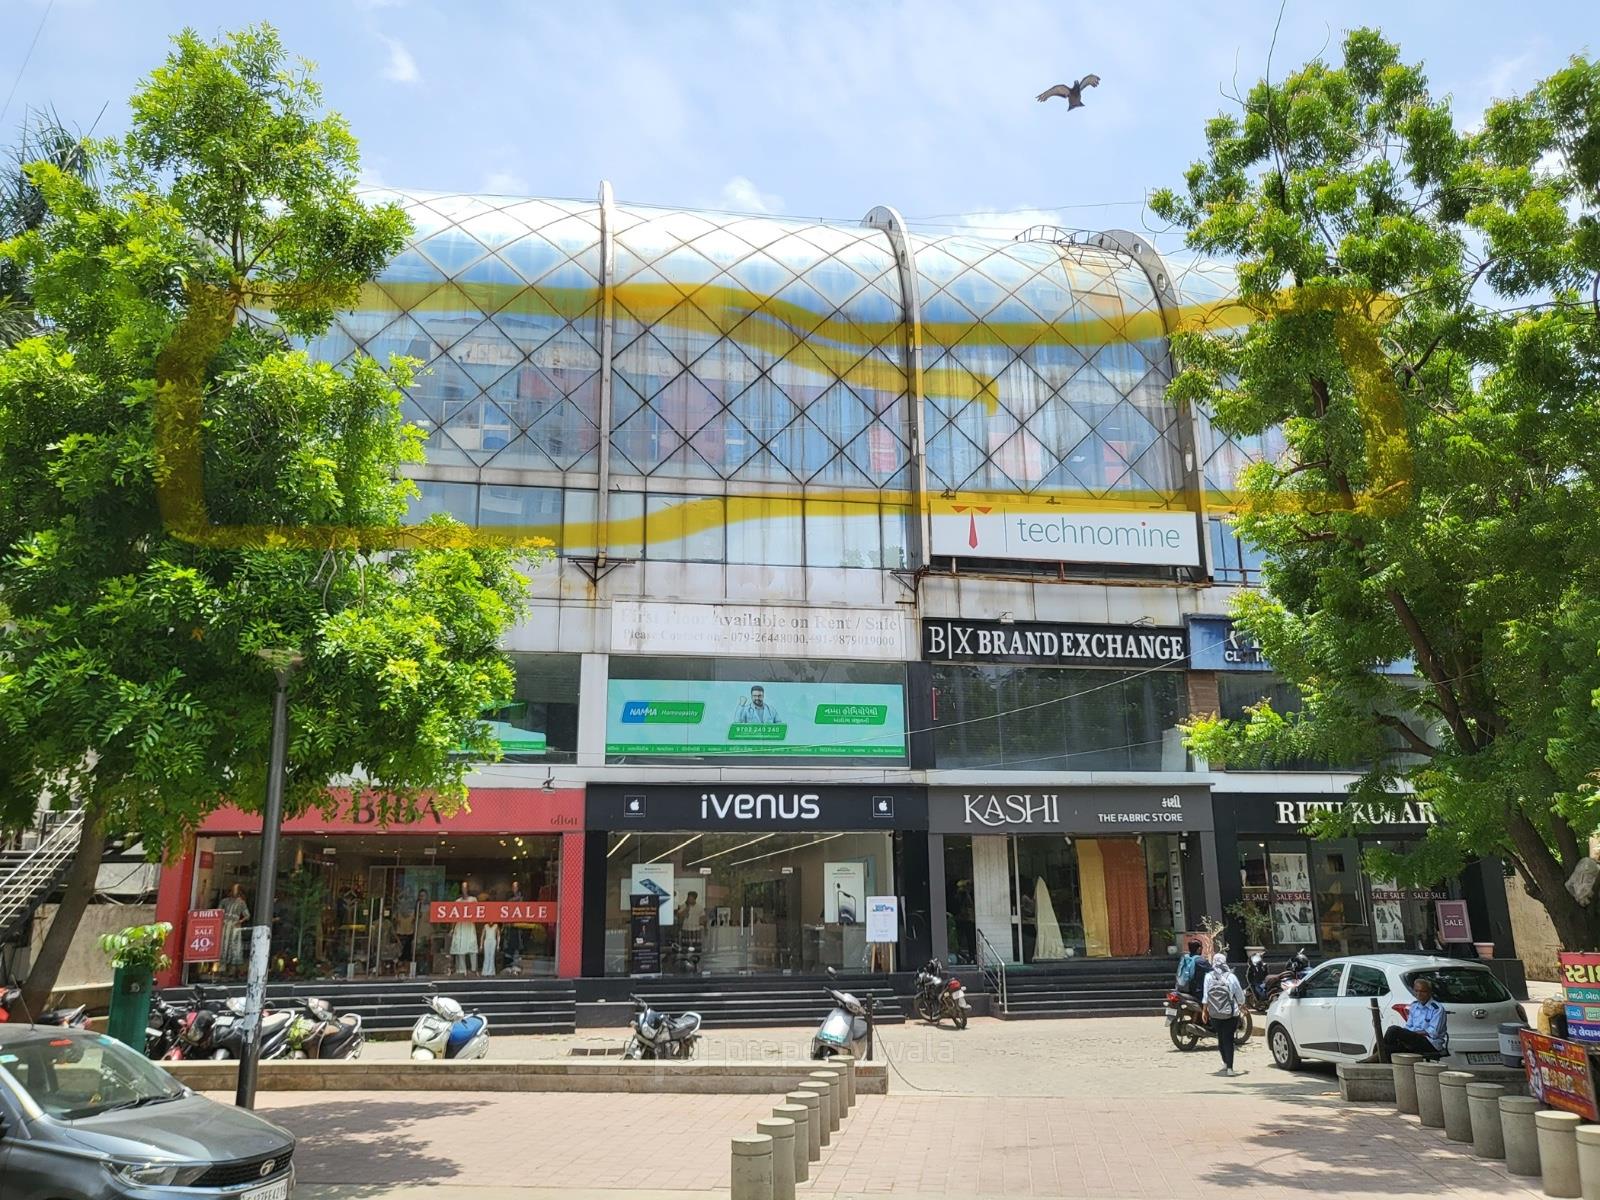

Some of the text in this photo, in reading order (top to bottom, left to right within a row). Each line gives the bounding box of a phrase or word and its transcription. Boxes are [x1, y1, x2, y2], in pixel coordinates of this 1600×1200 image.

[1017, 517, 1180, 549] technomine
[791, 618, 809, 628] on
[629, 707, 658, 717] NAMMA
[963, 794, 1060, 826] KASHI
[1276, 801, 1343, 824] RITU
[1098, 813, 1184, 823] THE FABRIC STORE
[1371, 892, 1406, 900] SALE SALE
[1413, 892, 1429, 900] SALE
[437, 906, 548, 919] SALE SALE
